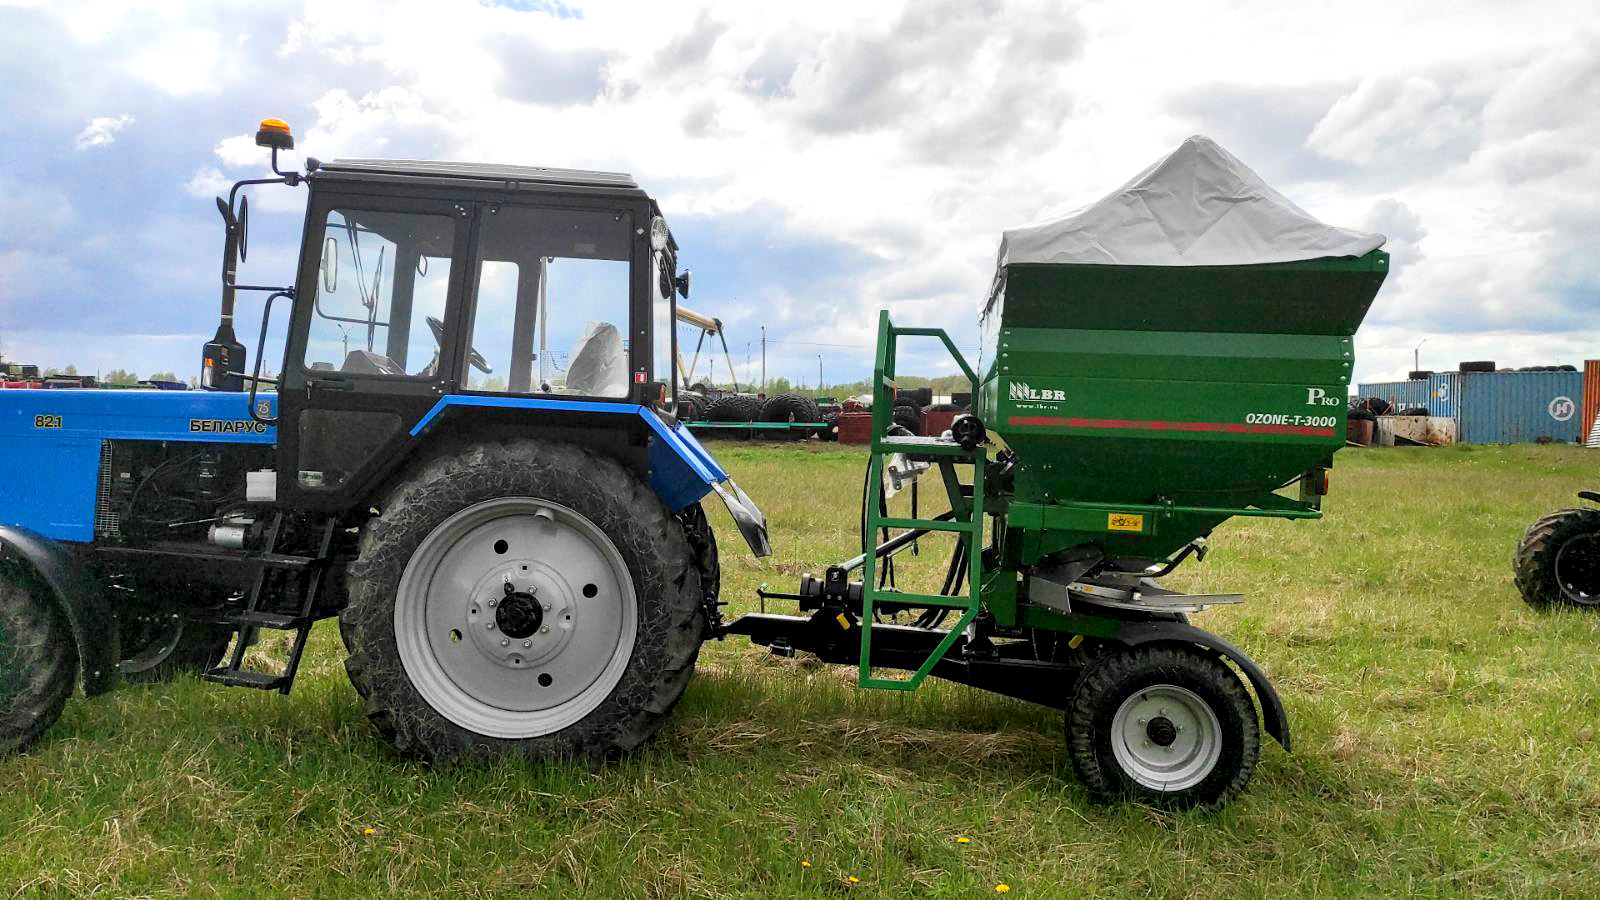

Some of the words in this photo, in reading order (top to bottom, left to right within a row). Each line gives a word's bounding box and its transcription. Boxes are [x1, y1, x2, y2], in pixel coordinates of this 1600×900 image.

[1029, 389, 1066, 401] LBR
[1016, 403, 1059, 411] www.lbr.ru
[190, 419, 267, 433] БЕЛАРУС
[1246, 413, 1337, 427] OZONE-T-3000
